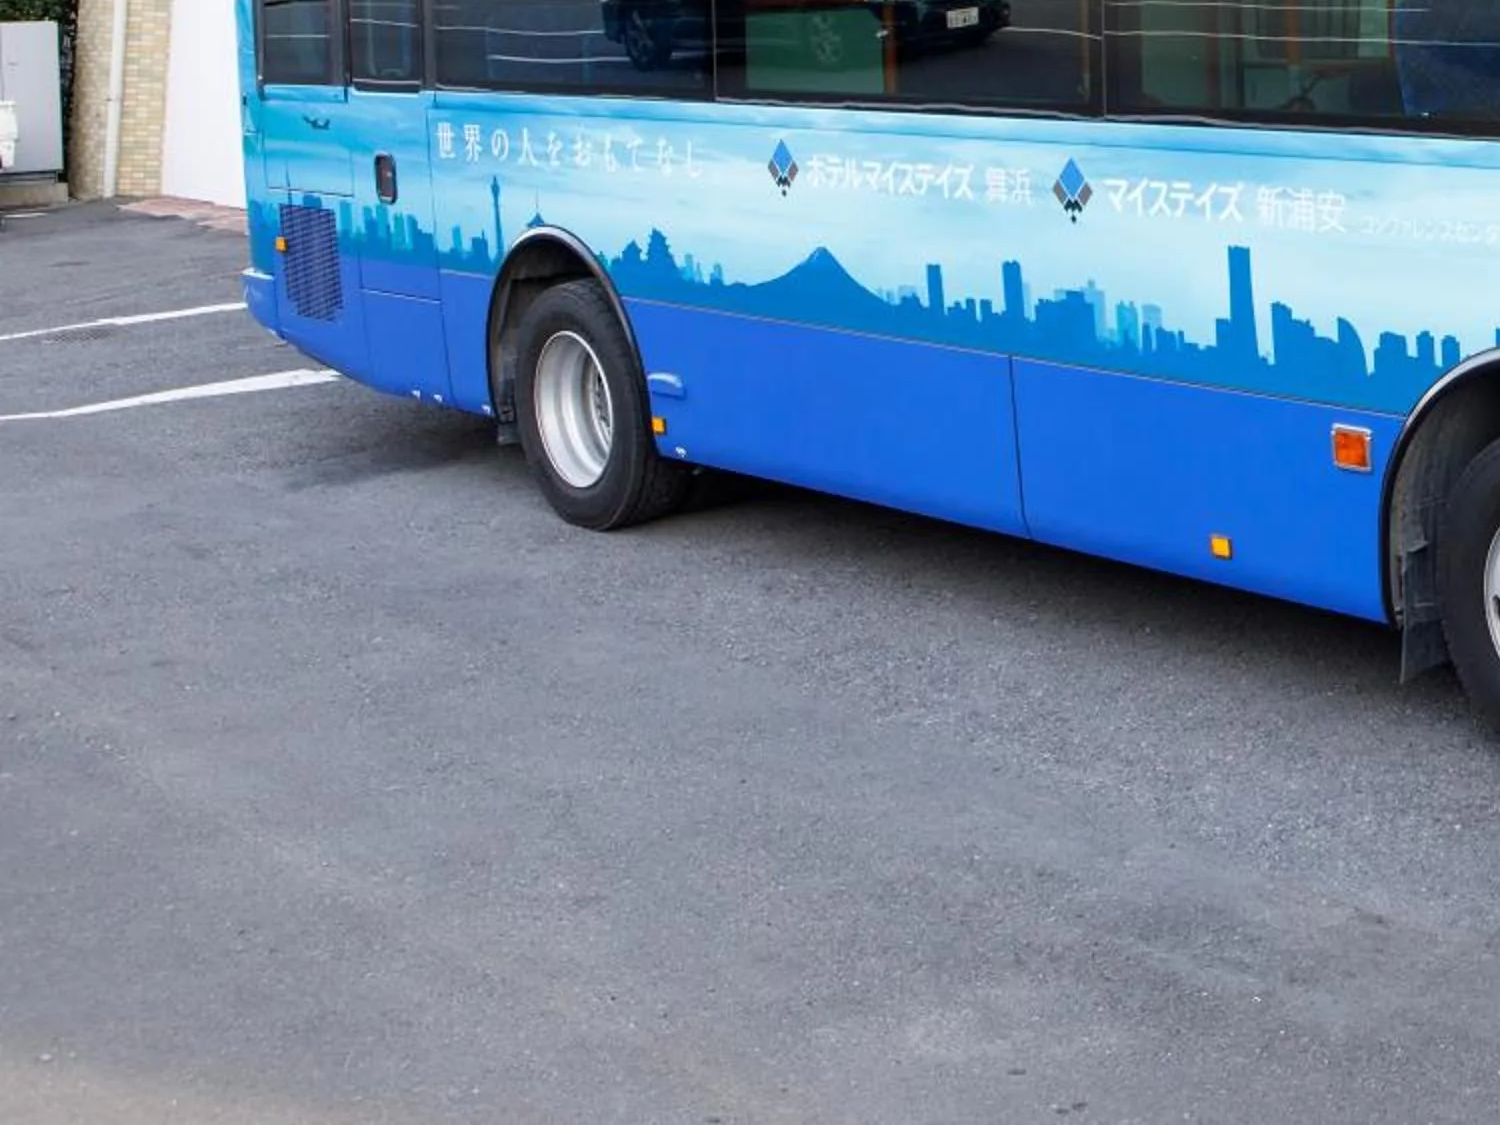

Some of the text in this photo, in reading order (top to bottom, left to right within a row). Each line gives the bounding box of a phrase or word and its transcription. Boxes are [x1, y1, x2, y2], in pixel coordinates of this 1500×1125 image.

[435, 122, 703, 178] 世界の人をおもてなし
[806, 154, 1034, 205] ホテルマイステイズ 舞浜
[1103, 178, 1244, 222] マイステイズ
[1256, 186, 1346, 234] 新浦安
